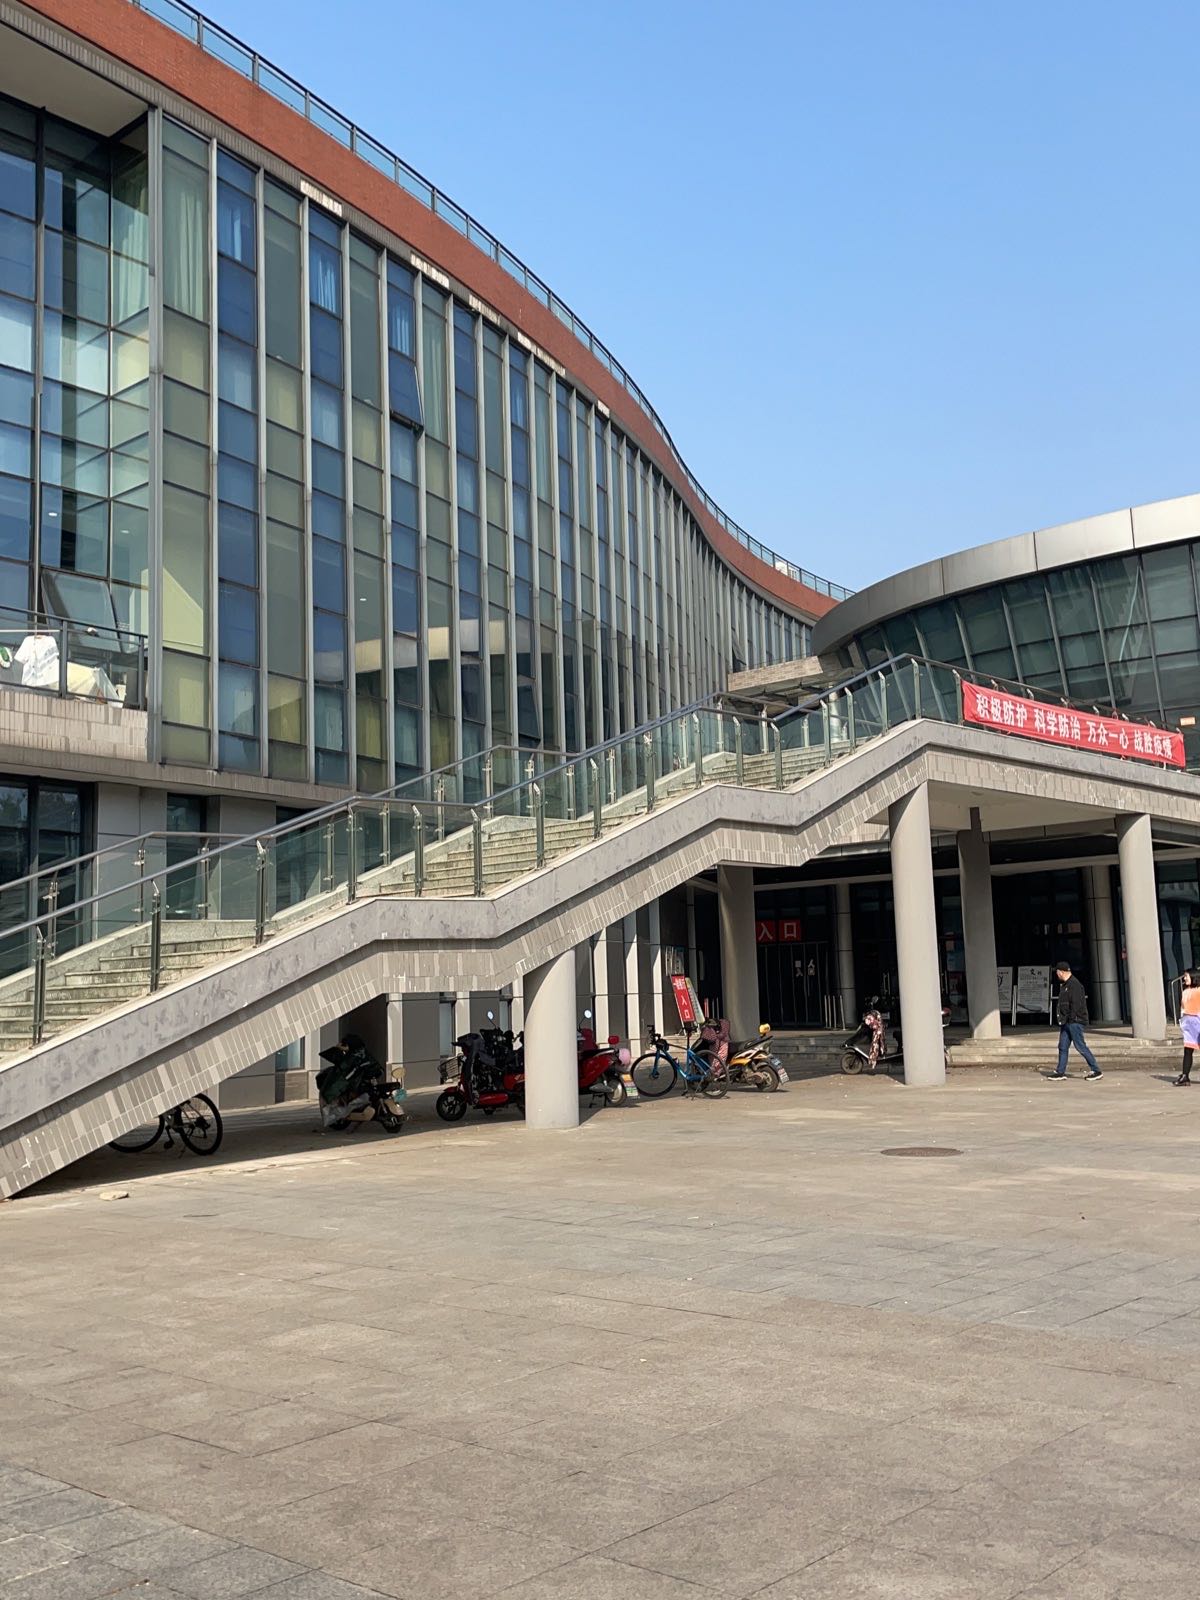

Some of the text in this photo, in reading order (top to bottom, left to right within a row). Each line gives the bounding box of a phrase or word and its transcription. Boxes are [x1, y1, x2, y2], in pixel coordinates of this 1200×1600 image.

[976, 694, 1172, 758] 积极防护 科学防治 万众一心 战胜疫情
[758, 922, 797, 940] 入口
